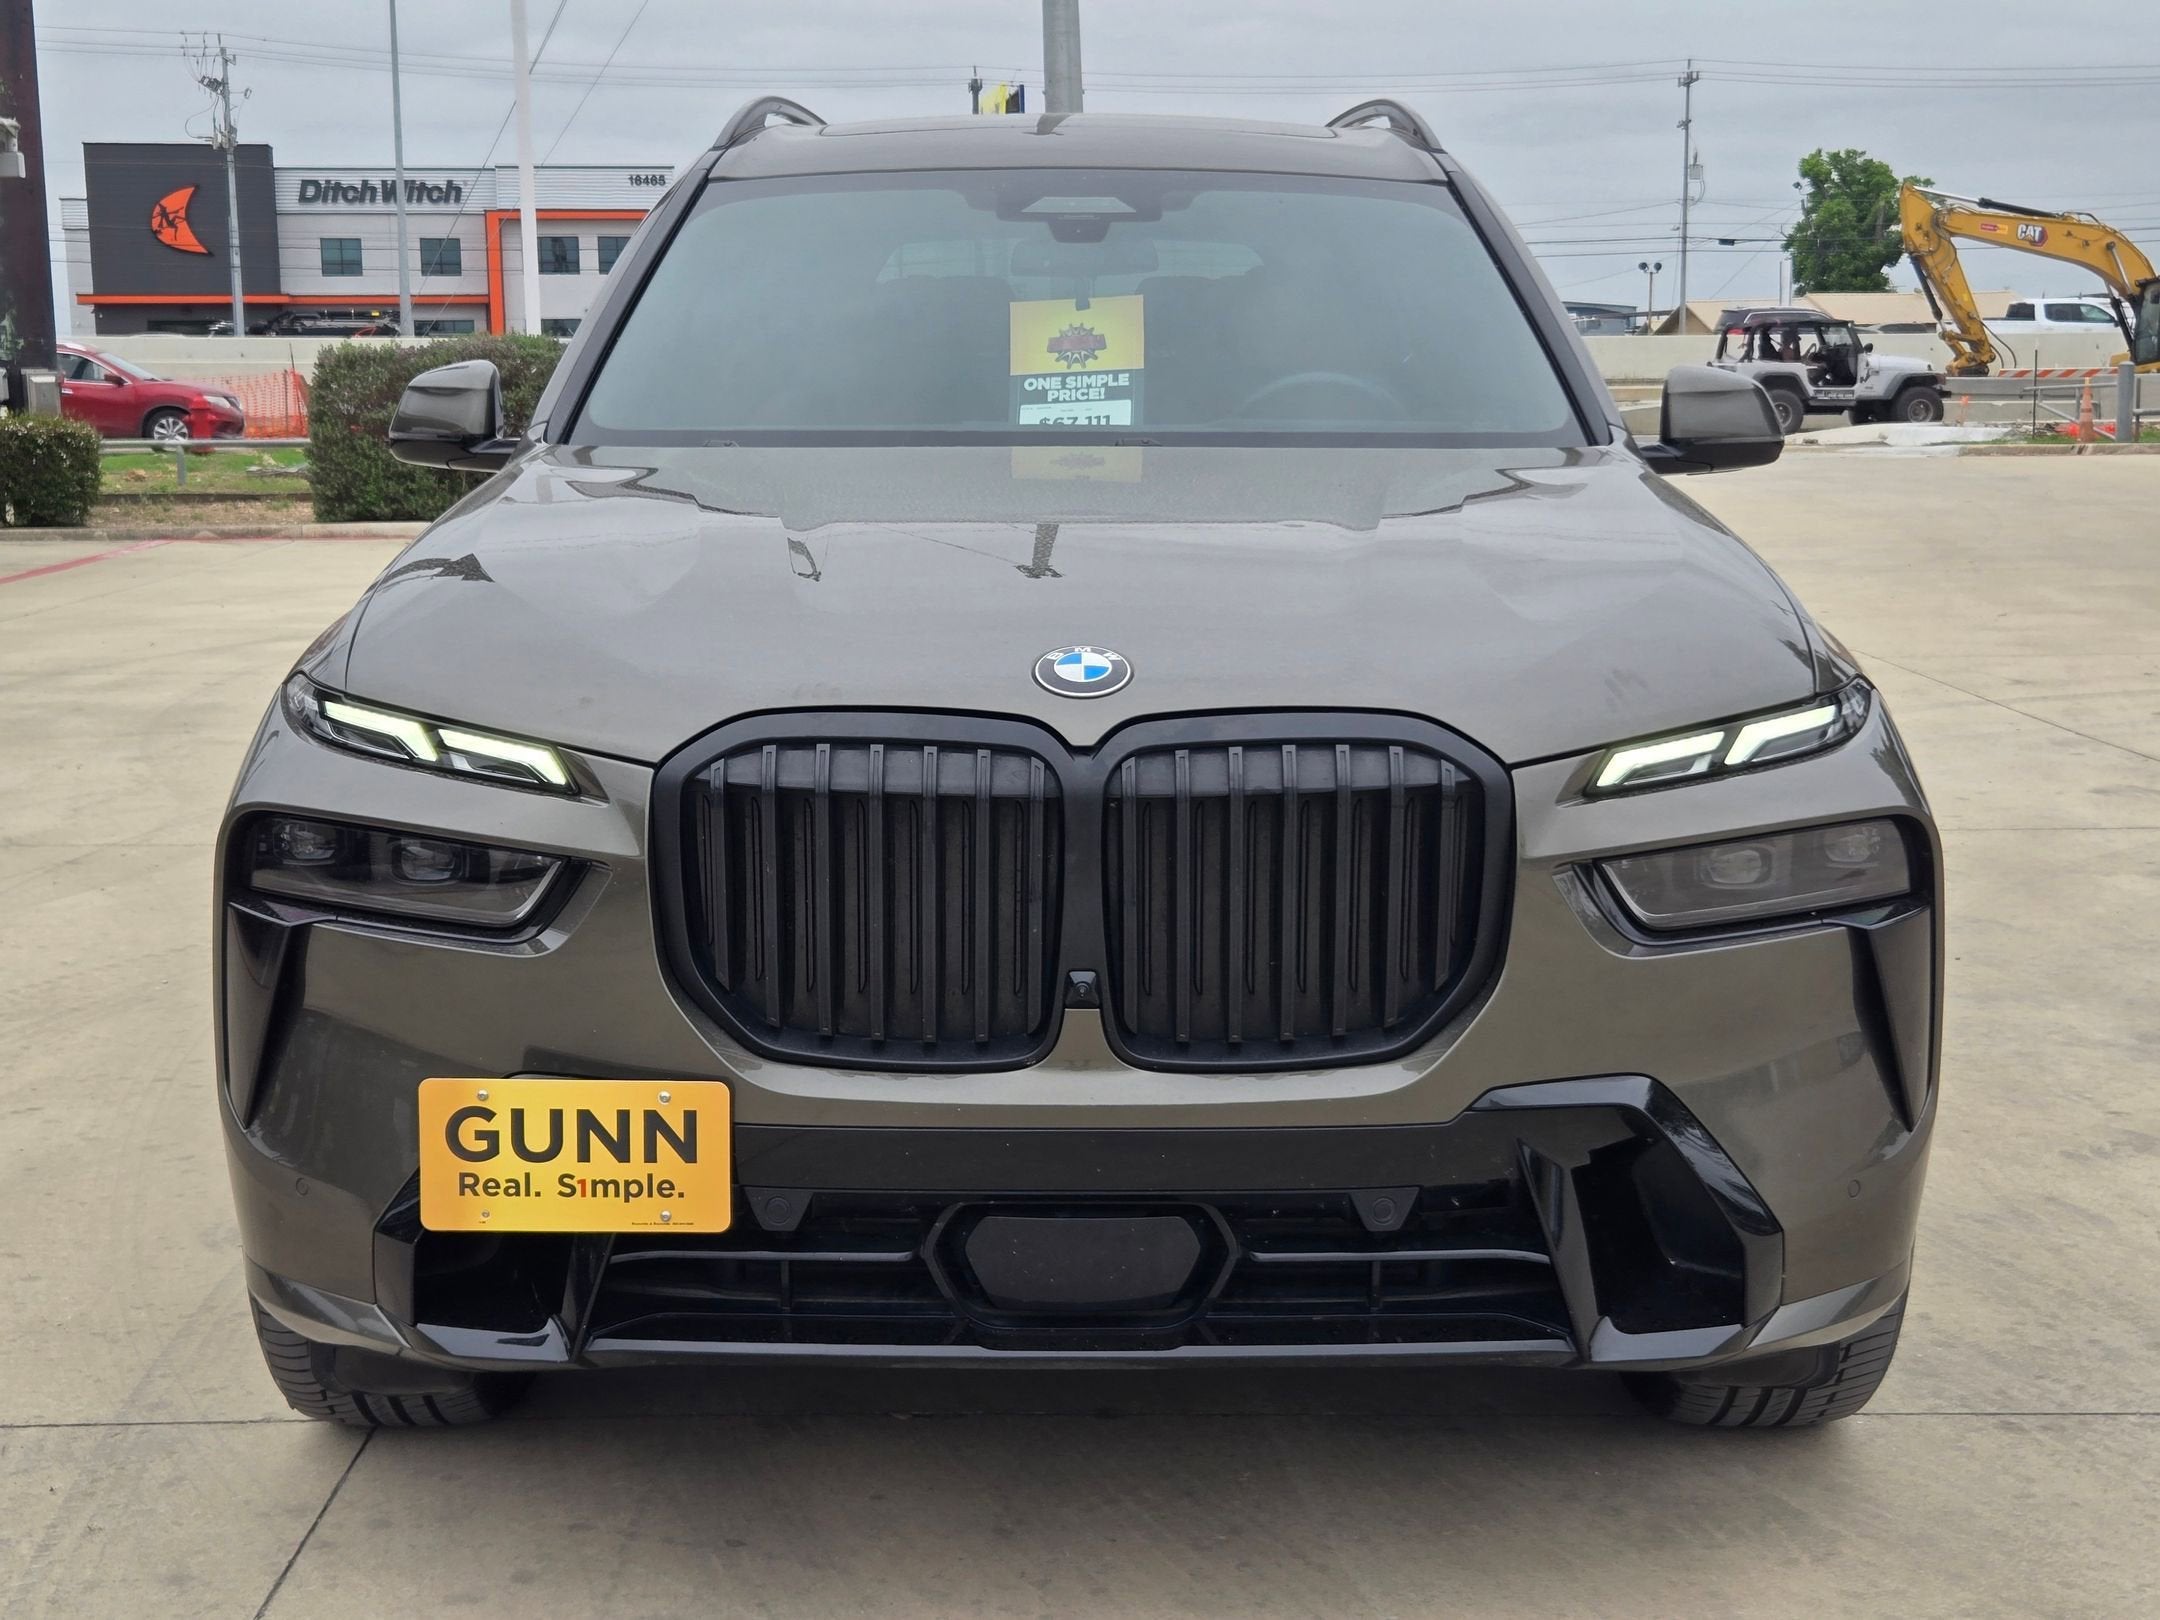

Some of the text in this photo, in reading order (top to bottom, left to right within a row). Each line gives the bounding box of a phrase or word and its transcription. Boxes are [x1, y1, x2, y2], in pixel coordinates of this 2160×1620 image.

[628, 174, 666, 186] 16465
[298, 179, 463, 204] Ditch Witch
[2017, 223, 2043, 242] CAT
[1023, 373, 1130, 392] ONE SIMPLE
[1047, 387, 1106, 402] PRICE!
[1038, 414, 1111, 426] $67111
[1046, 646, 1121, 661] BMW
[445, 1105, 698, 1164] GUNN
[458, 1172, 542, 1198] Real.
